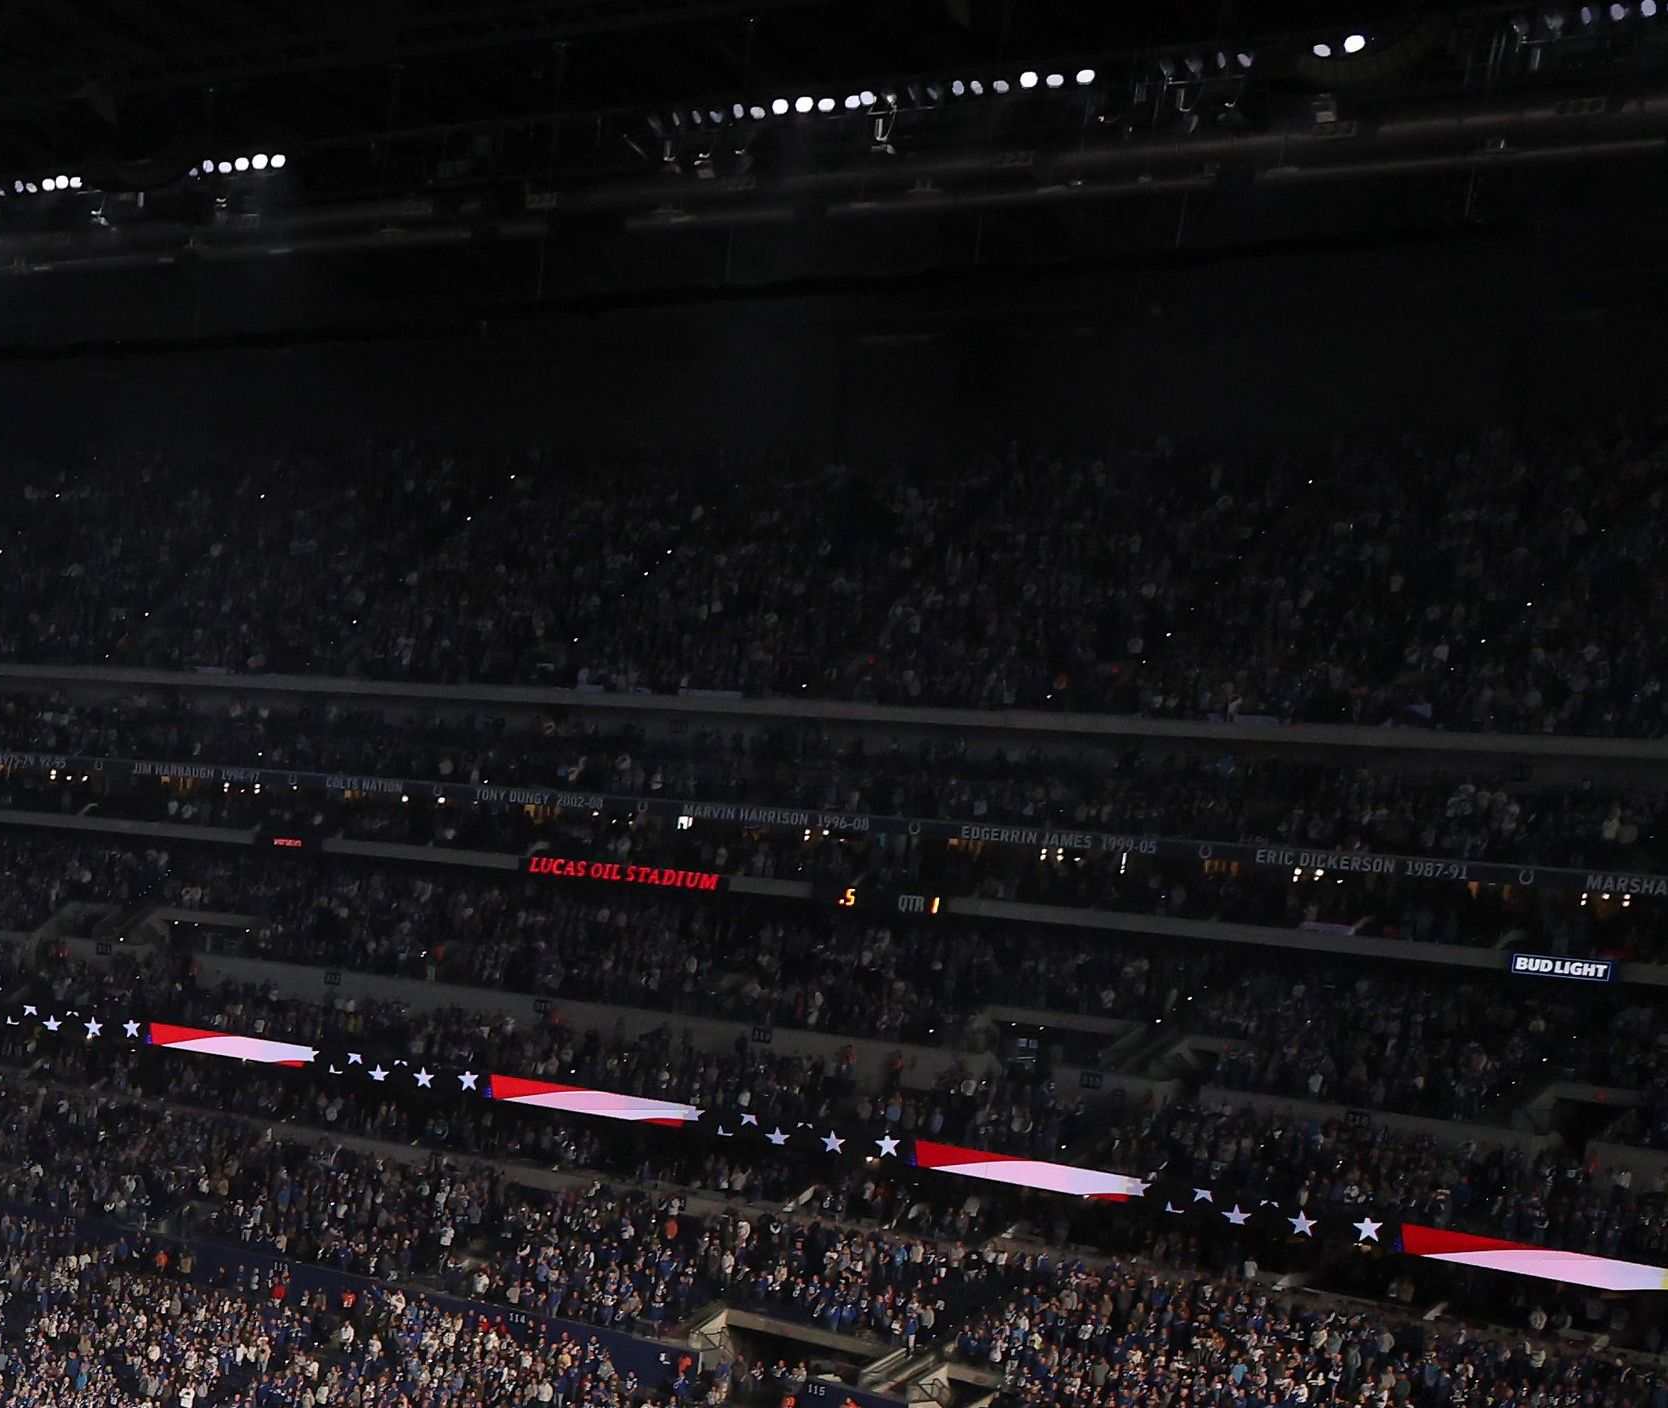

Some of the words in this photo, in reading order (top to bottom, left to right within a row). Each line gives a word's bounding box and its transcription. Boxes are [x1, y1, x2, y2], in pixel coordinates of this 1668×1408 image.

[476, 787, 507, 800] TONY
[509, 790, 551, 805] DUNGY
[683, 803, 737, 821] MARVIN
[739, 807, 809, 826] HARRISON
[960, 825, 1039, 846] EDGERRIN
[1043, 831, 1093, 850] JAMES
[528, 856, 587, 876] LUCAS
[590, 861, 621, 881] OIL
[625, 866, 721, 893] STADIUM
[1254, 849, 1297, 867] ERIC
[1299, 853, 1396, 874] DICKERSON
[1404, 859, 1469, 881] 1987-91
[897, 893, 925, 913] QTR
[1514, 956, 1559, 974] BUD
[1560, 960, 1608, 979] LIGHT
[508, 1311, 526, 1324] 114
[807, 1383, 826, 1396] 115
